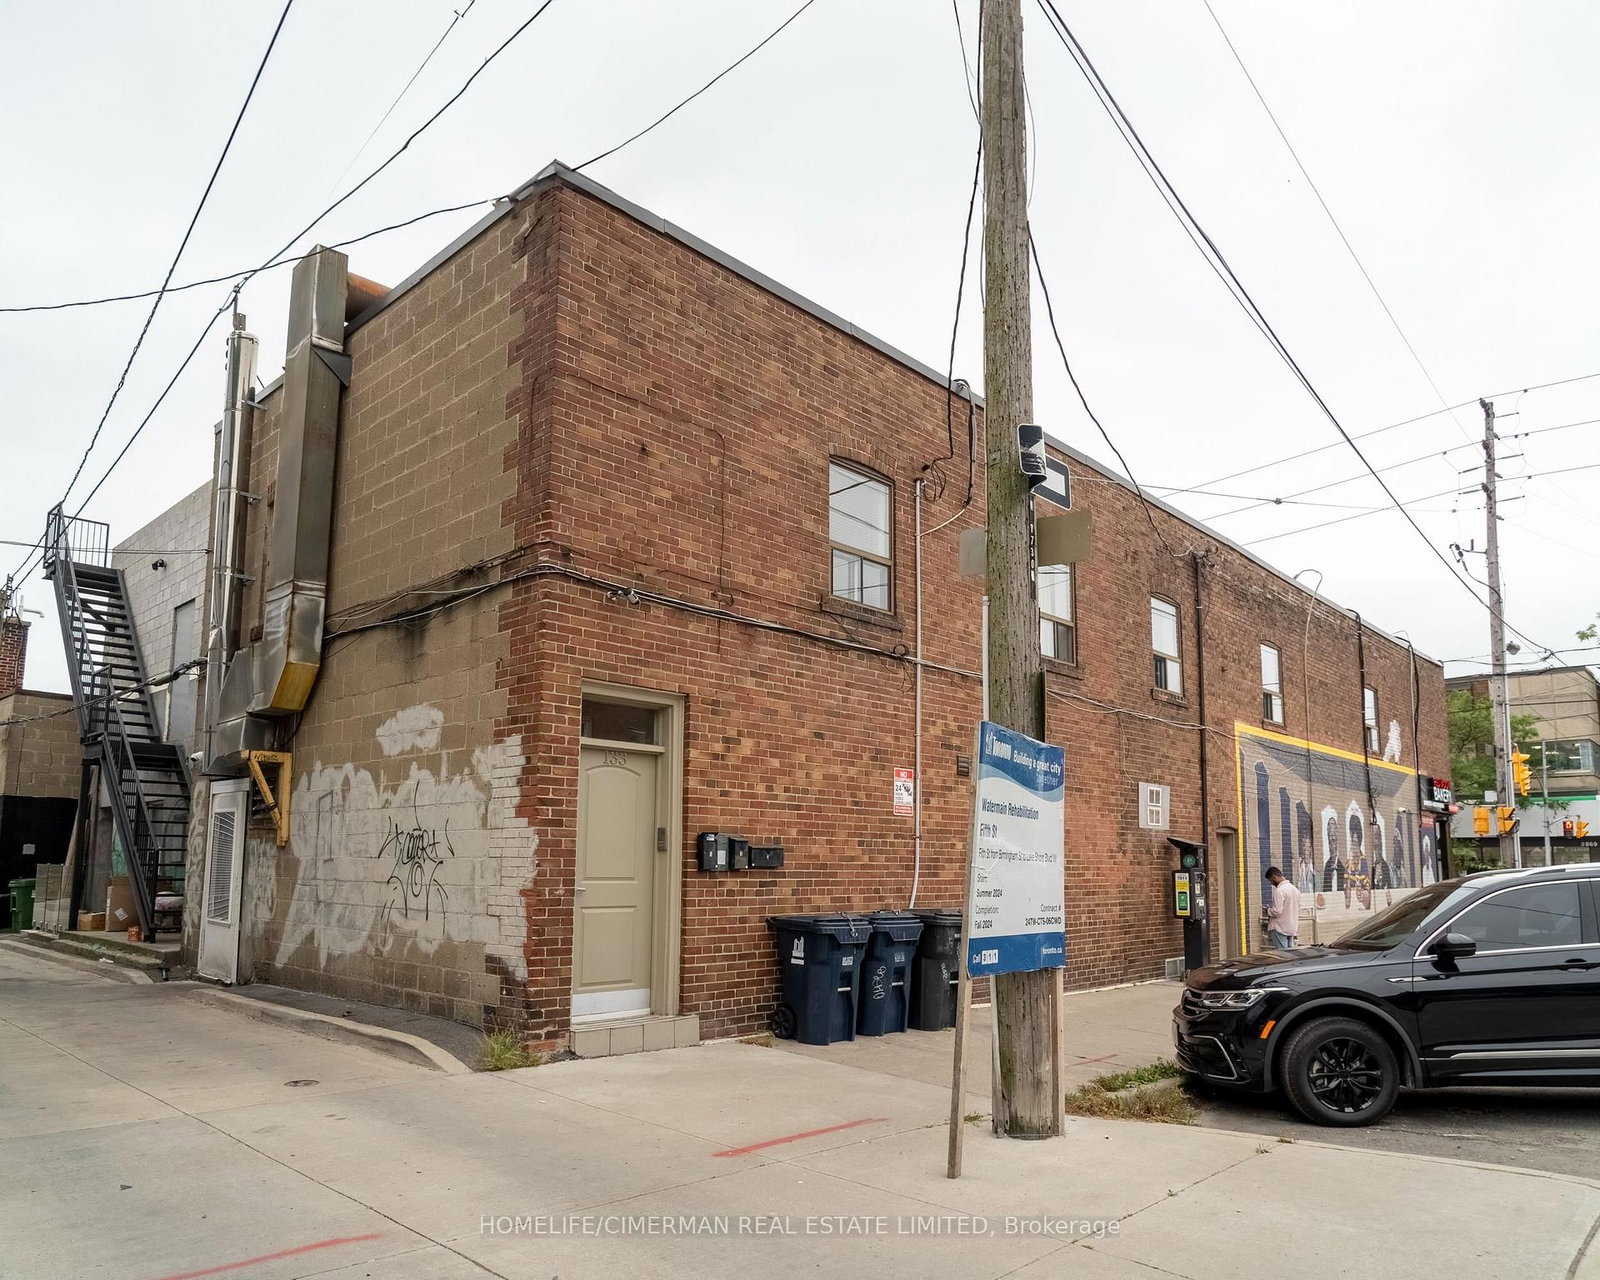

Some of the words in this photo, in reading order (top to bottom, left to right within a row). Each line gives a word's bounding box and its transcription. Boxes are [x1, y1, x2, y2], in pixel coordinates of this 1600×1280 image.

[1013, 750, 1033, 770] Building
[1037, 760, 1050, 772] great
[1050, 761, 1062, 777] city
[981, 797, 1007, 815] Watermain
[1007, 803, 1039, 820] Rehabilitation
[980, 823, 990, 837] Fifth
[991, 824, 998, 838] St
[976, 889, 992, 897] Summer
[993, 889, 1002, 898] 2024
[1040, 904, 1057, 912] Contract
[982, 919, 992, 929] 2024
